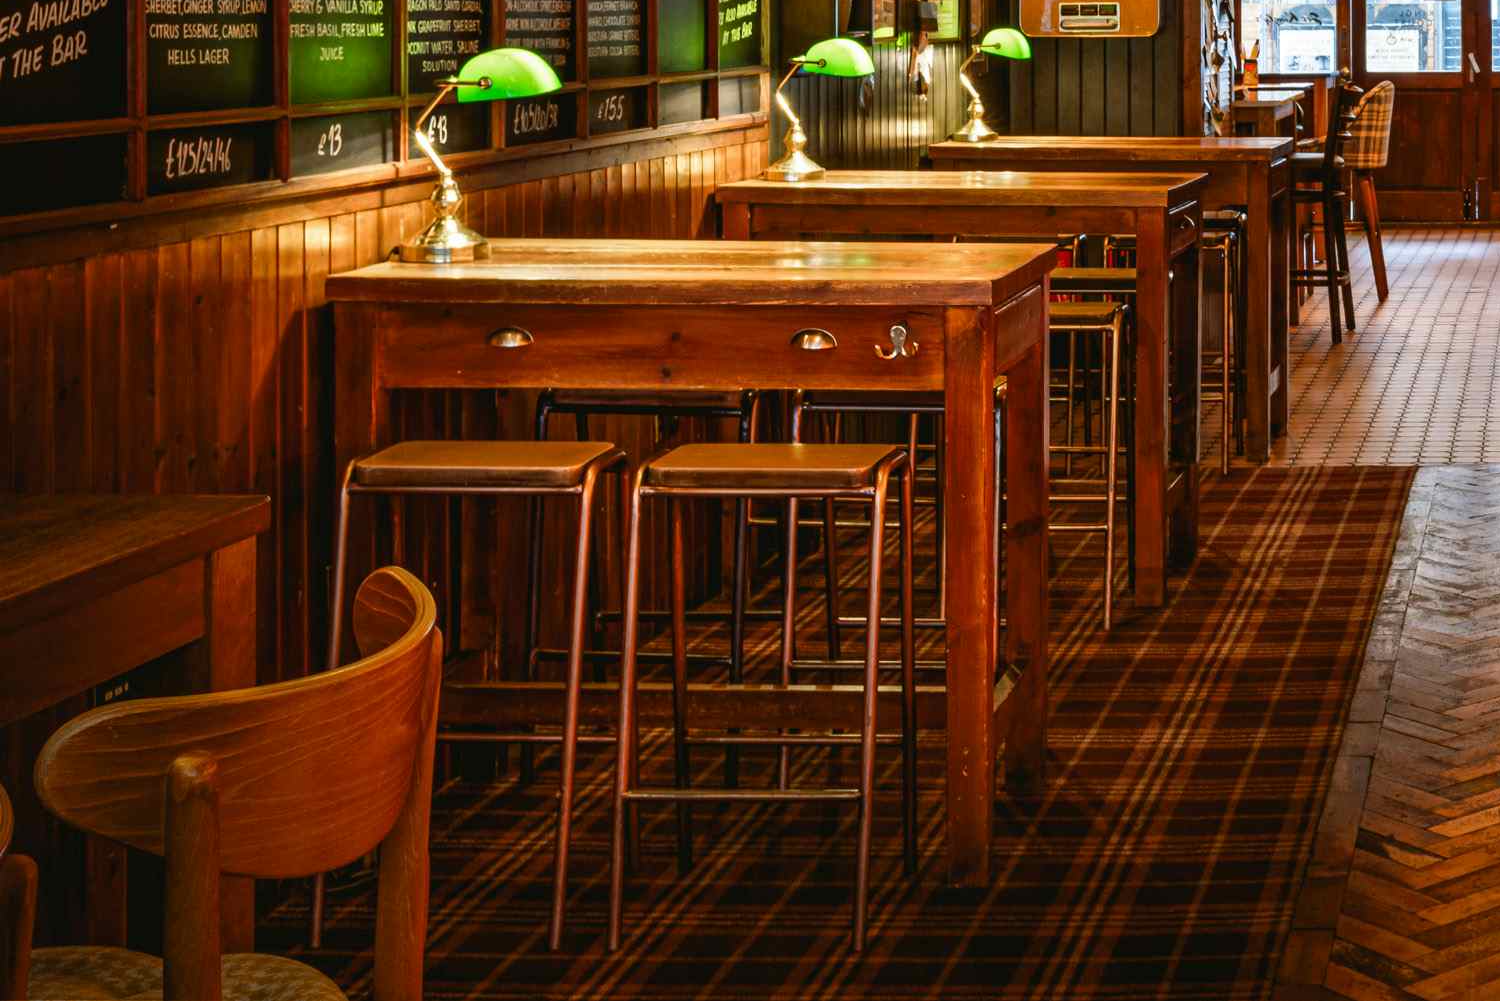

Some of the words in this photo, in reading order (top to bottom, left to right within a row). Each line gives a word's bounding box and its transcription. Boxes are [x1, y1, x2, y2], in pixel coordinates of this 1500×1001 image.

[325, 0, 358, 15] VANILLA
[149, 22, 180, 39] CITRUS
[221, 22, 259, 39] CAMDEN
[289, 22, 315, 38] FRESH
[341, 22, 366, 38] FRESH
[12, 45, 44, 78] THE
[50, 30, 88, 66] BAR
[168, 48, 197, 65] HELLS
[199, 47, 231, 65] LAGER
[319, 45, 344, 61] JUICE
[422, 60, 457, 73] SOLUTION
